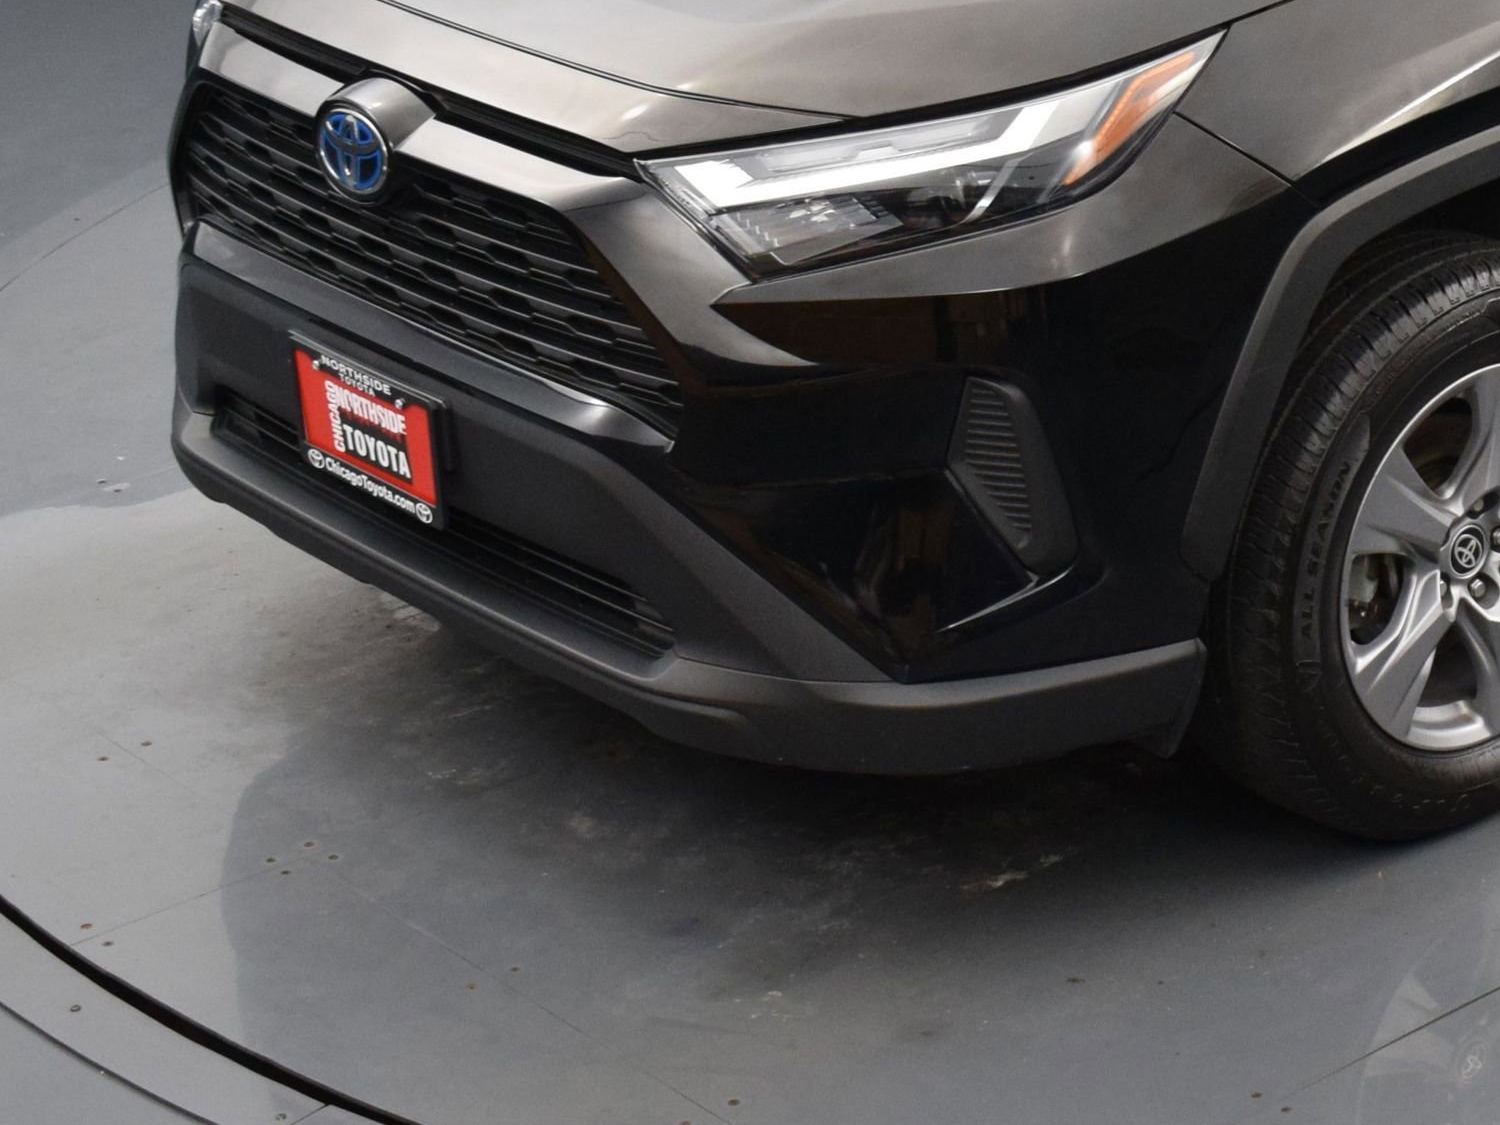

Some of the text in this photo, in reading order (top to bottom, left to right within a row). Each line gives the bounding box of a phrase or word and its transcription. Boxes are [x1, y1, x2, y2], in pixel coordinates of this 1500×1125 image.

[321, 355, 391, 395] NORTHSIDE
[339, 374, 375, 397] TOYOTA
[324, 380, 345, 452] CHICAGO
[335, 384, 407, 435] NORTHSIDE
[343, 424, 411, 478] TOYOTA
[326, 457, 415, 513] ChicagoToyota.com
